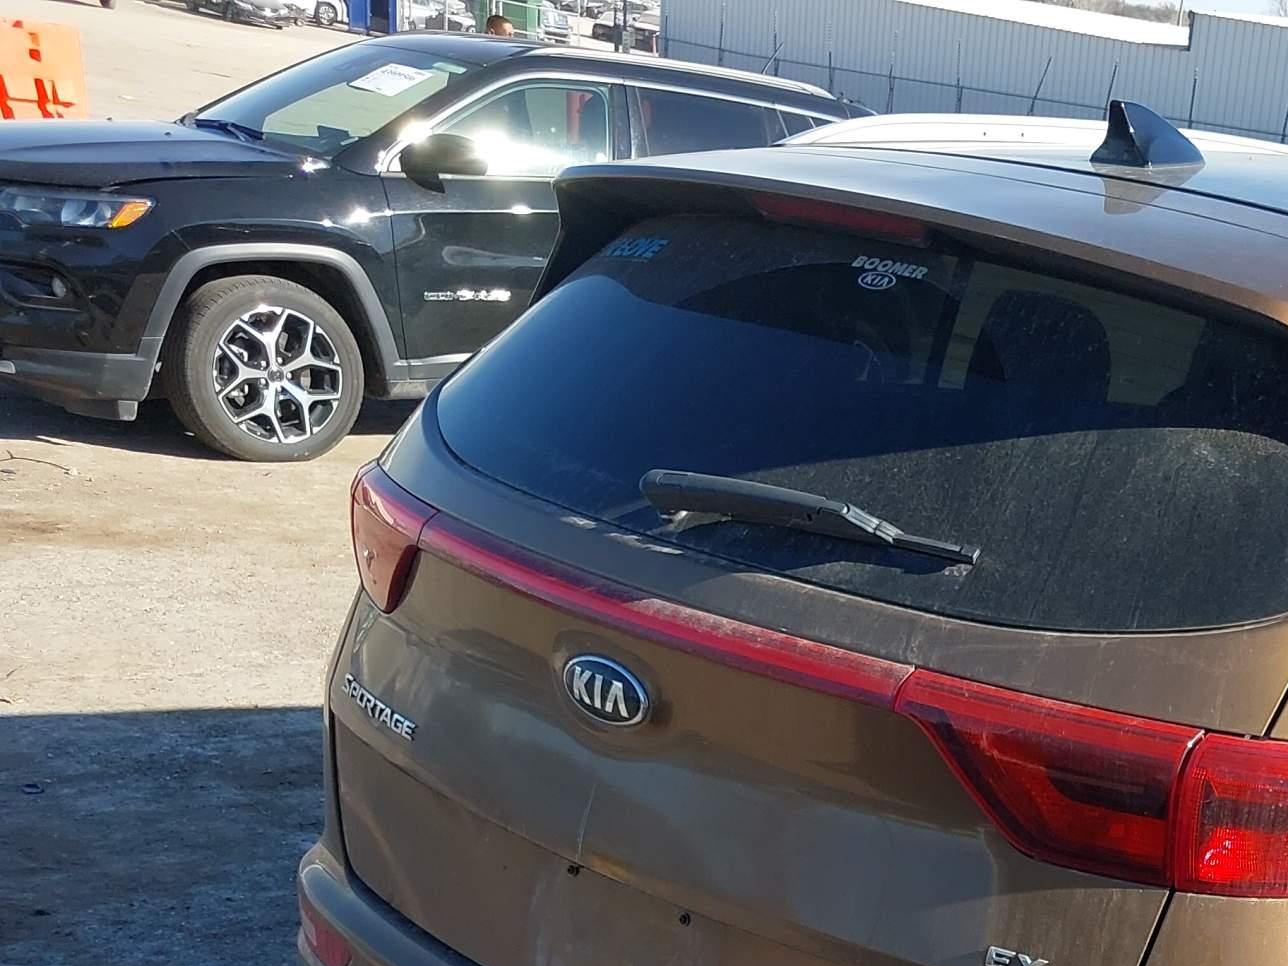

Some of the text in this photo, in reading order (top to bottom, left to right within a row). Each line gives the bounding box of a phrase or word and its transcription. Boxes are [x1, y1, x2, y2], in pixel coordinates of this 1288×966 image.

[851, 255, 929, 280] BOOMER
[341, 672, 417, 742] SPORTAGE
[571, 664, 631, 720] KIA
